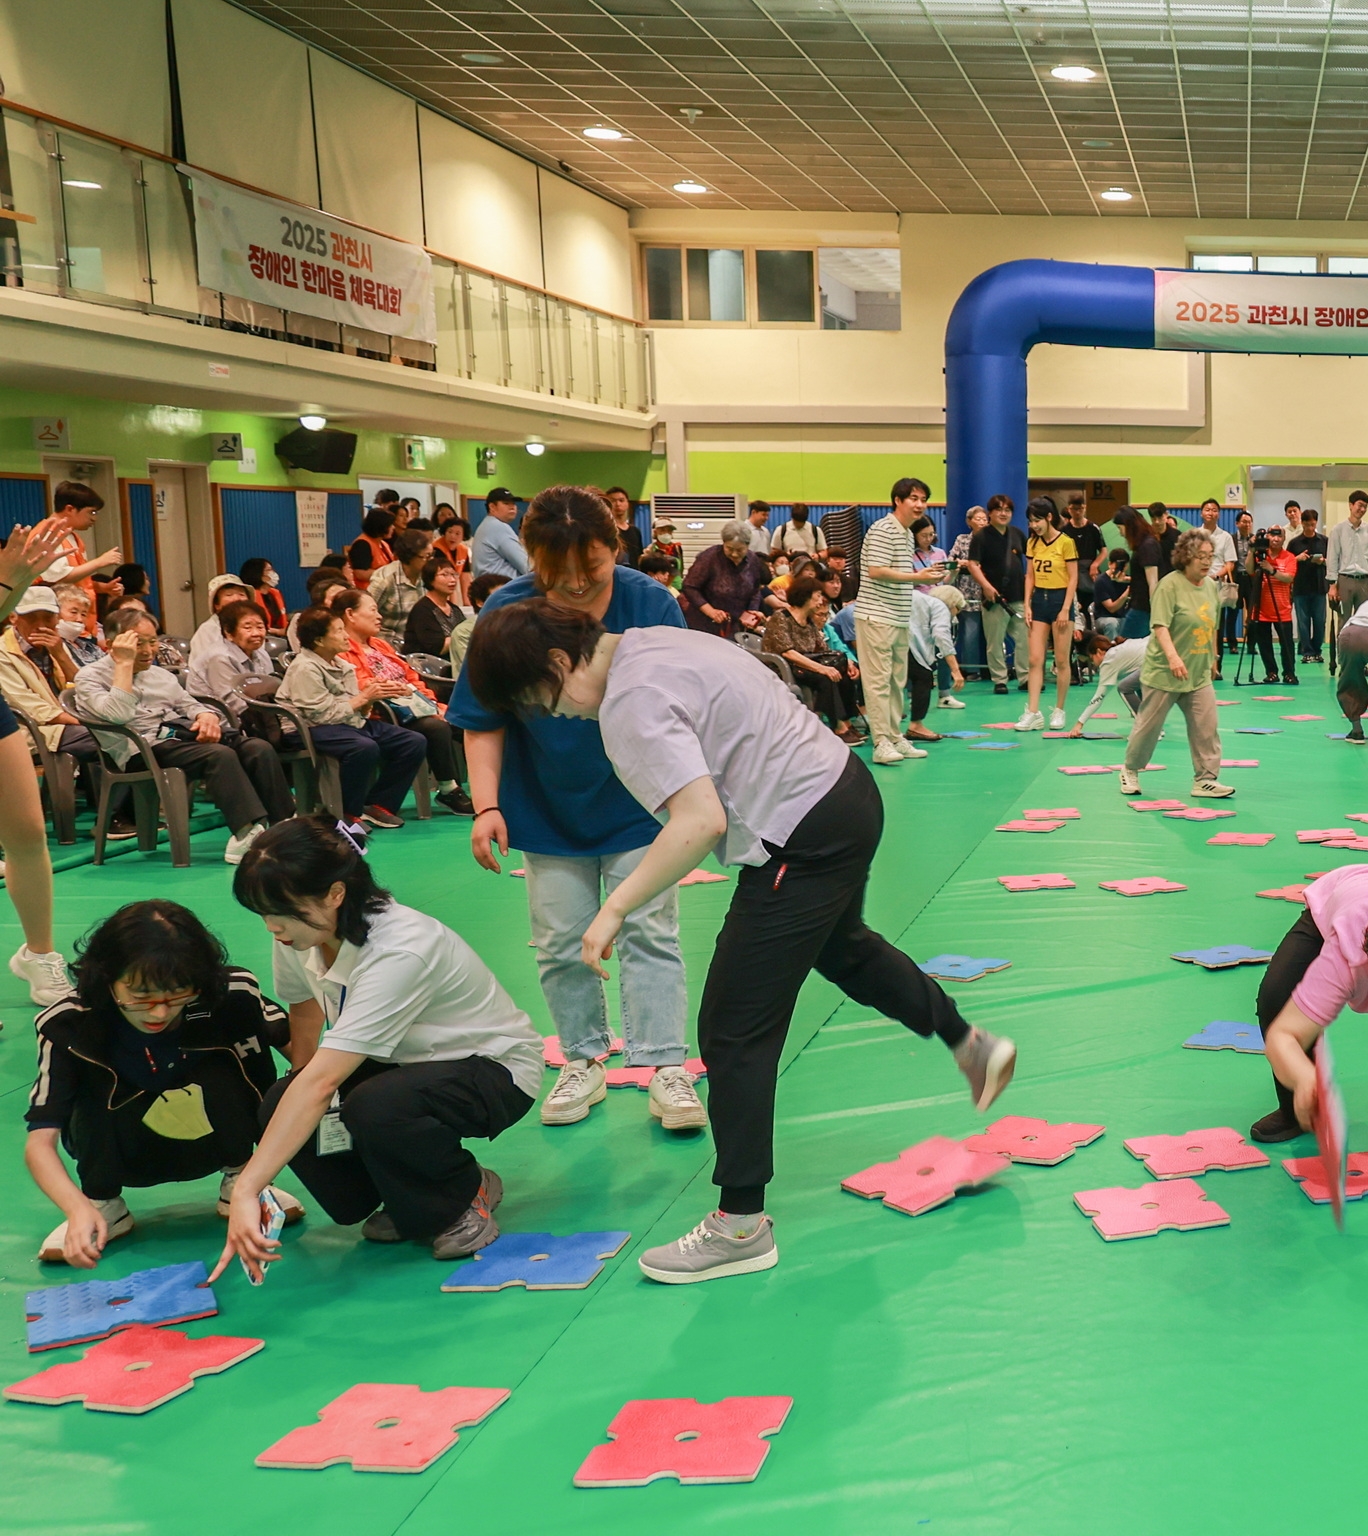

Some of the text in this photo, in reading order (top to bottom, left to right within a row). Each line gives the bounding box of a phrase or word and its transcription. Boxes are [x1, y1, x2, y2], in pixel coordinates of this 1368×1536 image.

[280, 216, 373, 273] 2025 과천시
[248, 244, 402, 316] 장애인 한마음 체육대회
[1175, 301, 1239, 324] 2025
[1247, 305, 1309, 326] 과천시
[1034, 559, 1052, 573] 72
